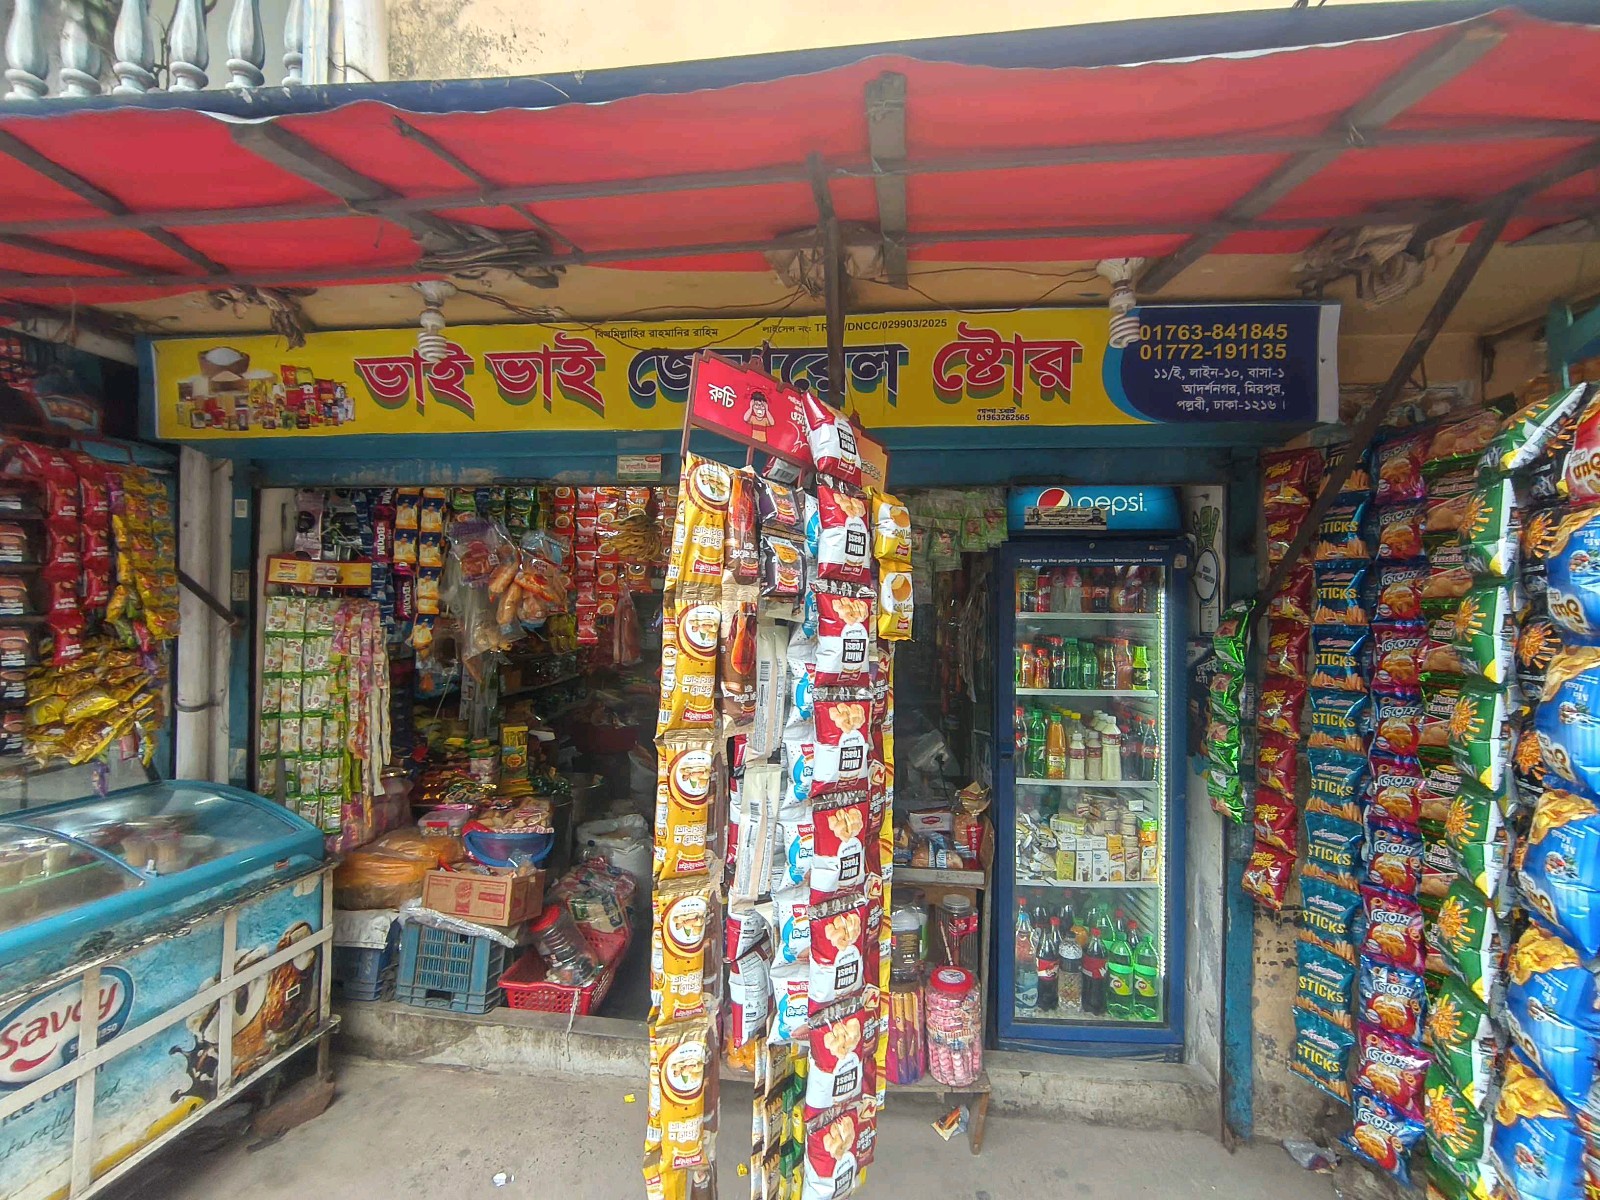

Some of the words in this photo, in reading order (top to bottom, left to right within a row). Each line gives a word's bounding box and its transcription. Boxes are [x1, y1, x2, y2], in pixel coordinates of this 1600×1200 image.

[649, 328, 689, 338] রাহমানির
[692, 327, 718, 337] রাহিম
[815, 318, 947, 332] TR/DNCC/029903/2025
[1139, 323, 1288, 341] 01763-841845
[1139, 343, 1287, 360] 01772-191135
[354, 341, 475, 421] ভাই
[484, 329, 605, 418] ভাই
[1189, 366, 1244, 380] লাইন-১০,
[1248, 367, 1285, 379] বাসা-১
[708, 383, 737, 408] রুচি
[1182, 381, 1241, 396] আদর্শনগর,
[1245, 381, 1285, 396] মিরপুর,
[1177, 397, 1210, 413] পল্লবী,
[1213, 399, 1277, 412] ঢাকা-১২১৬
[1078, 493, 1144, 515] pepsi
[1319, 521, 1358, 534] STICKS
[847, 543, 865, 557] Mini
[1317, 586, 1358, 599] STICKS
[1551, 599, 1584, 624] Sun
[845, 649, 864, 663] Mini
[1315, 652, 1359, 667] STICKS
[1312, 713, 1356, 728] STICKS
[842, 757, 861, 772] Mini
[1312, 779, 1354, 796] STICKS
[1307, 844, 1352, 865] STICKS
[844, 868, 861, 881] Mini
[1302, 911, 1347, 934] STICKS
[836, 972, 857, 987] Mini
[1299, 976, 1345, 1002] STICKS
[1297, 1043, 1342, 1072] STICKS
[835, 1079, 855, 1094] Mini
